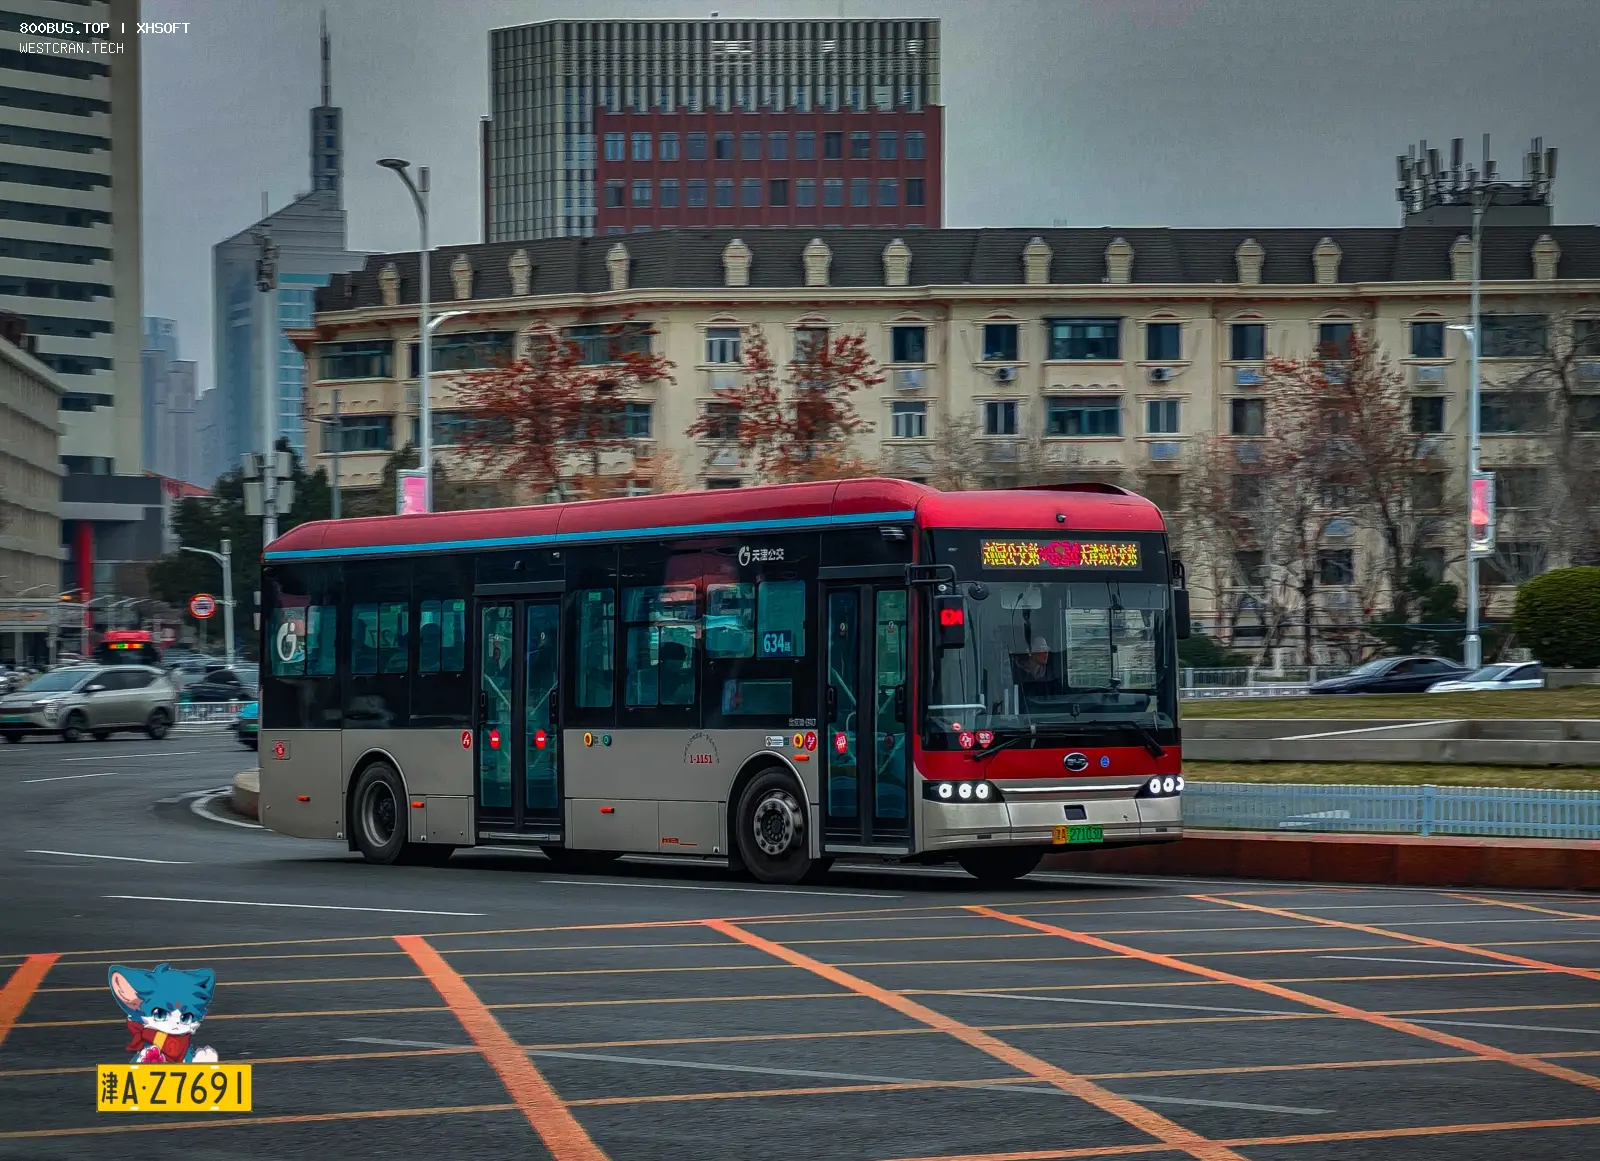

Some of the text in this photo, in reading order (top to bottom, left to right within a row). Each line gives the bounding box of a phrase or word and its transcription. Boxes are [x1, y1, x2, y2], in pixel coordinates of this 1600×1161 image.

[752, 548, 784, 562] 天津公交
[689, 754, 713, 764] 1-1151
